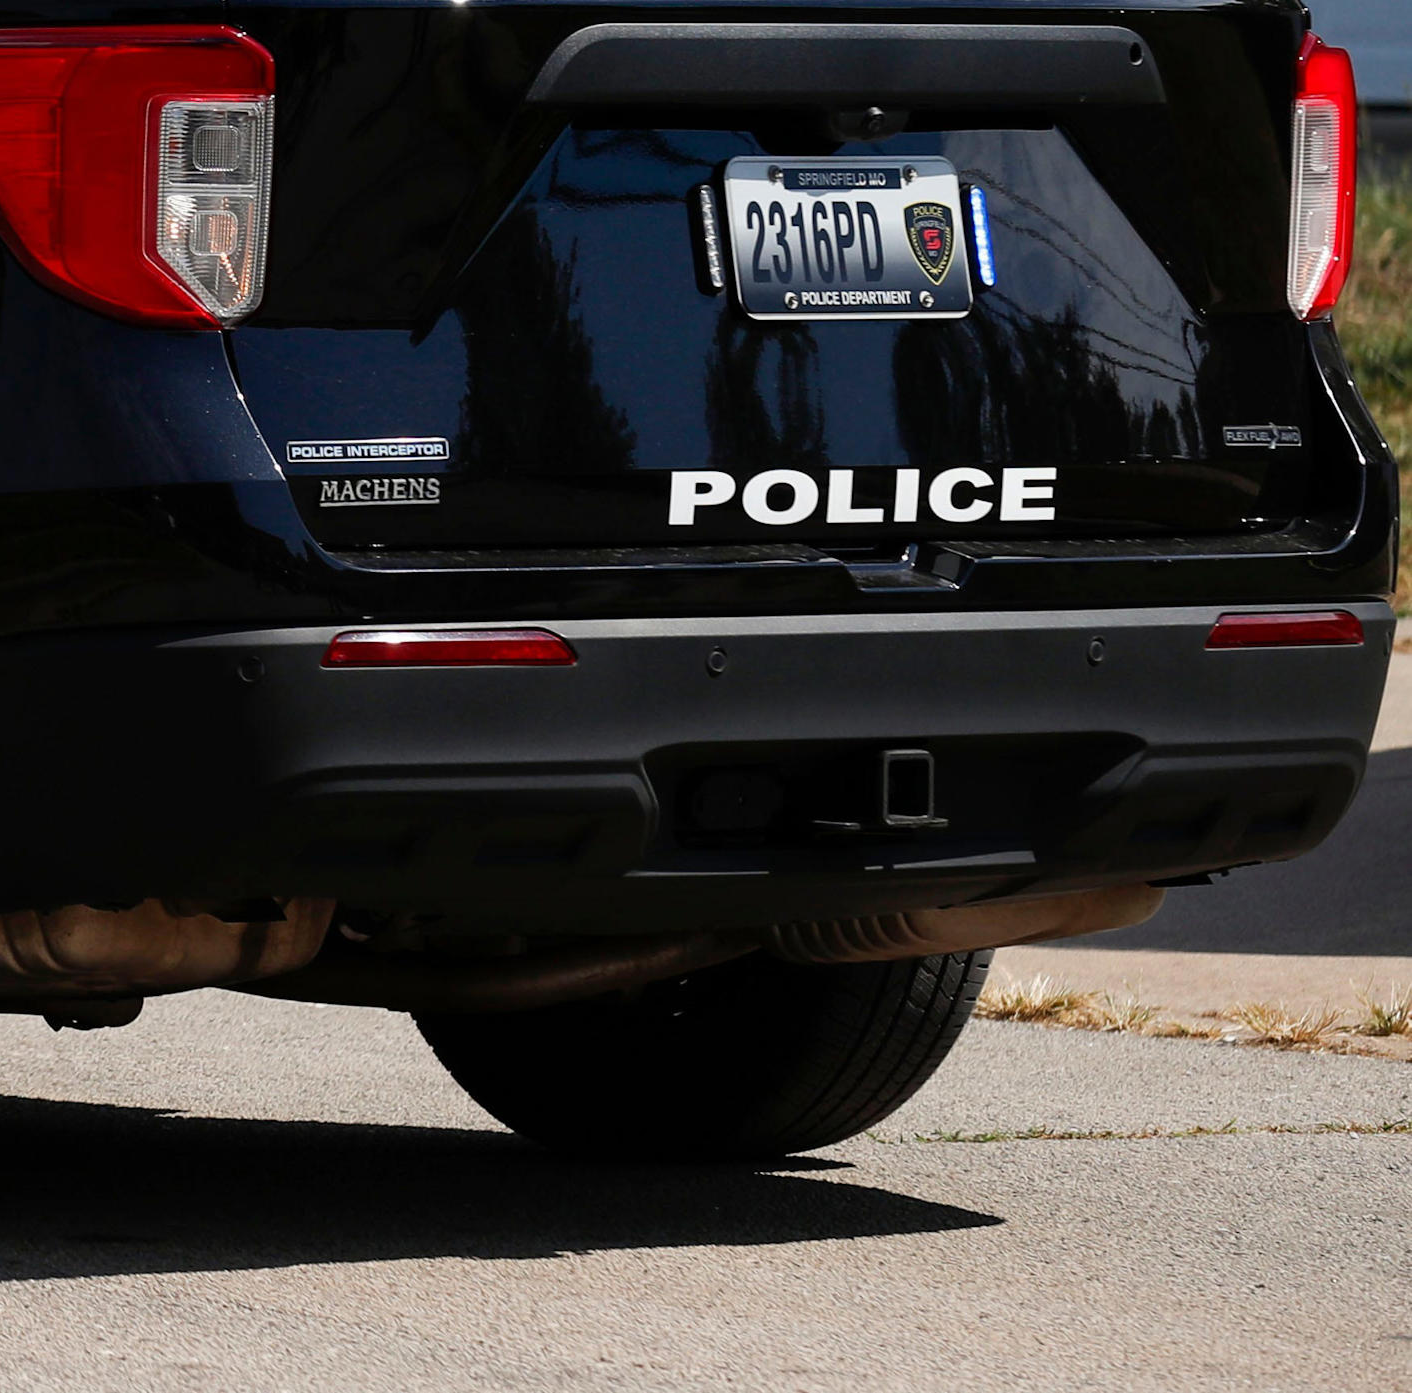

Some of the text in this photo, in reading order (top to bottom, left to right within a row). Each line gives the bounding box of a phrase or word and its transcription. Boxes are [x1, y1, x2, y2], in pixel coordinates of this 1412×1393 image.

[798, 171, 886, 185] SPRINGFIELD MO
[913, 206, 943, 217] POLICE
[747, 200, 884, 284] 2316PD
[801, 290, 912, 306] POLICE DEPARTMENT
[292, 444, 444, 458] POLICE INTERCEPTOR
[320, 478, 440, 501] MACHENS
[668, 467, 1057, 525] POLICE
